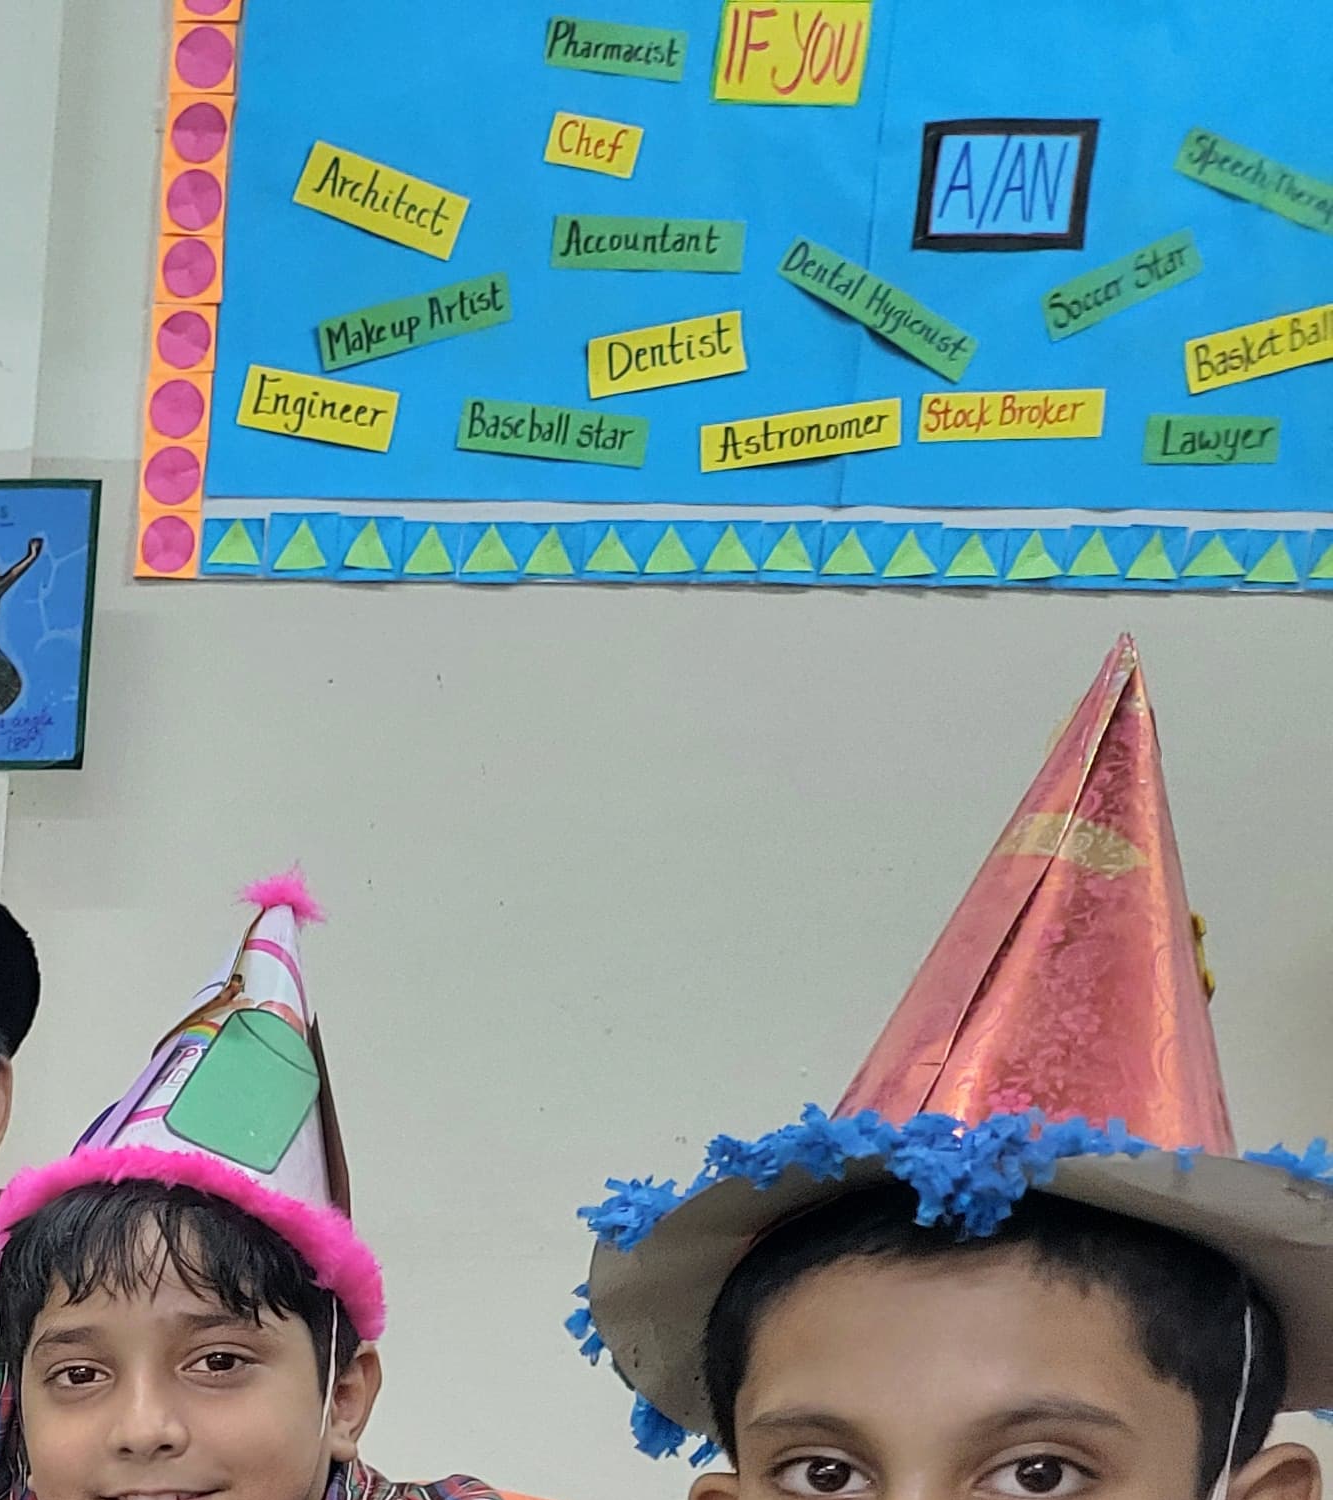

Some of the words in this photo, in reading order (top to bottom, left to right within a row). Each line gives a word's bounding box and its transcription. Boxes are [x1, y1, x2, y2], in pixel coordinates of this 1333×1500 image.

[548, 18, 680, 68] Pharmacist
[724, 6, 774, 86] IF
[770, 10, 864, 96] YOU
[558, 120, 628, 163] Chef
[312, 156, 451, 238] Architect
[937, 134, 1070, 229] A/AN
[560, 222, 721, 257] Accountant
[428, 280, 505, 331] Artist
[783, 238, 862, 301] Dental
[870, 280, 968, 364] Hygienist
[1048, 278, 1123, 330] Soccer
[1134, 243, 1192, 291] Star
[607, 324, 733, 381] Dentist
[1194, 328, 1285, 383] Basket
[252, 373, 389, 434] Engineer
[924, 397, 992, 434] Stock
[997, 396, 1086, 428] Broker
[715, 412, 890, 464] Astronomer
[1161, 419, 1276, 462] Lawyer
